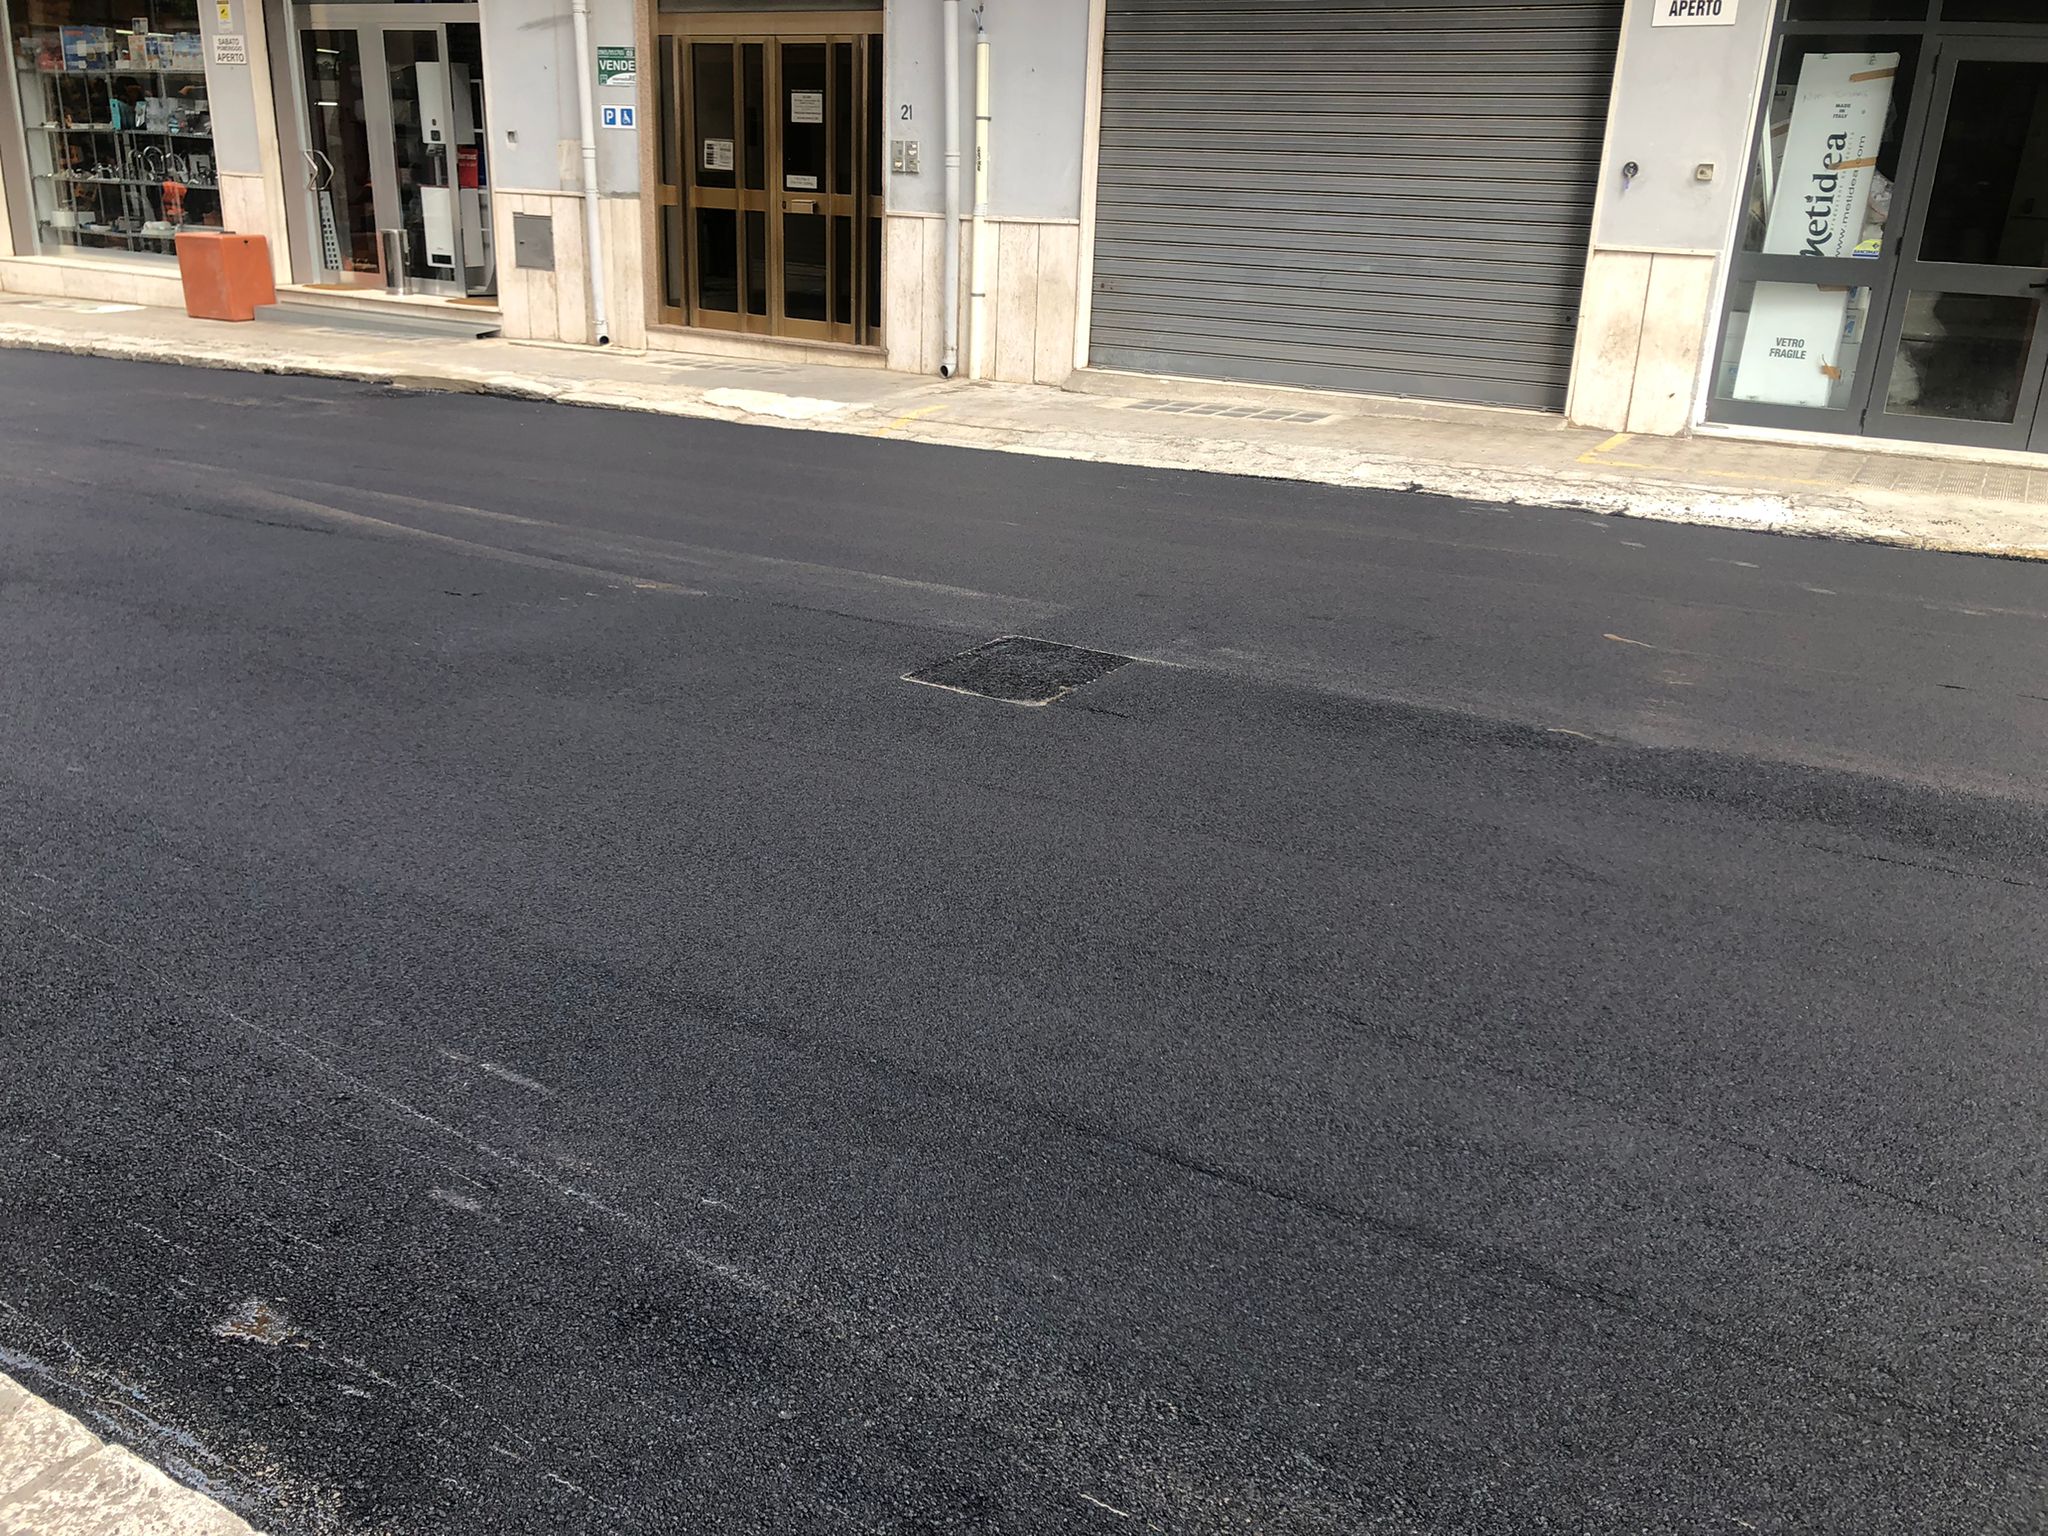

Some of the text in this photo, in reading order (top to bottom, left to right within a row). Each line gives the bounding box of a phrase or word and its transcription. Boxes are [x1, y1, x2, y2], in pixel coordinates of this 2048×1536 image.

[1668, 0, 1722, 16] APERTO
[217, 53, 245, 62] APERTO
[600, 60, 636, 71] VENDE
[606, 110, 615, 123] P
[901, 104, 912, 120] 21
[1776, 337, 1805, 348] VETRO
[1769, 347, 1807, 360] FRAGILE
